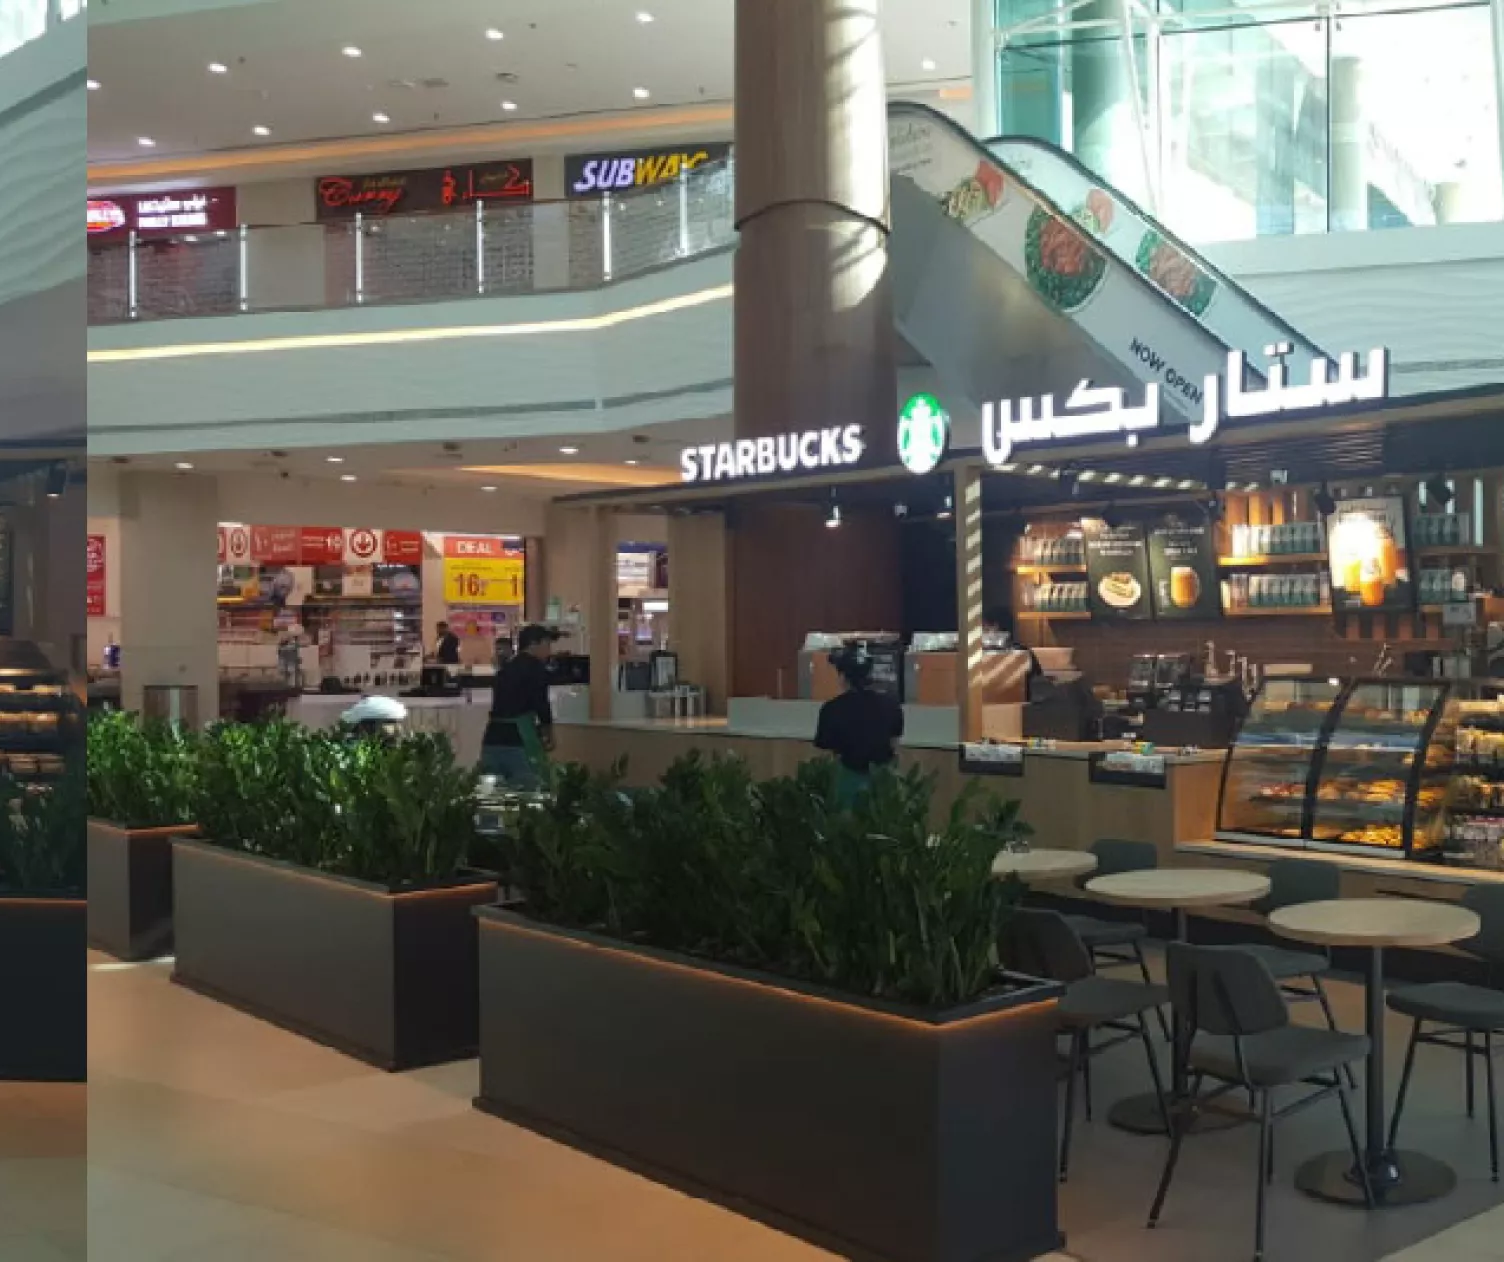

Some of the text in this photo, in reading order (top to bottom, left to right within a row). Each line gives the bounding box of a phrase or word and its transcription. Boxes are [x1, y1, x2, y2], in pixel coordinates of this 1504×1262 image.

[573, 150, 709, 192] SUBWAY
[1129, 336, 1203, 405] NOW OPEN
[981, 340, 1388, 466] ستار بكس
[679, 423, 866, 482] STARBUCKS
